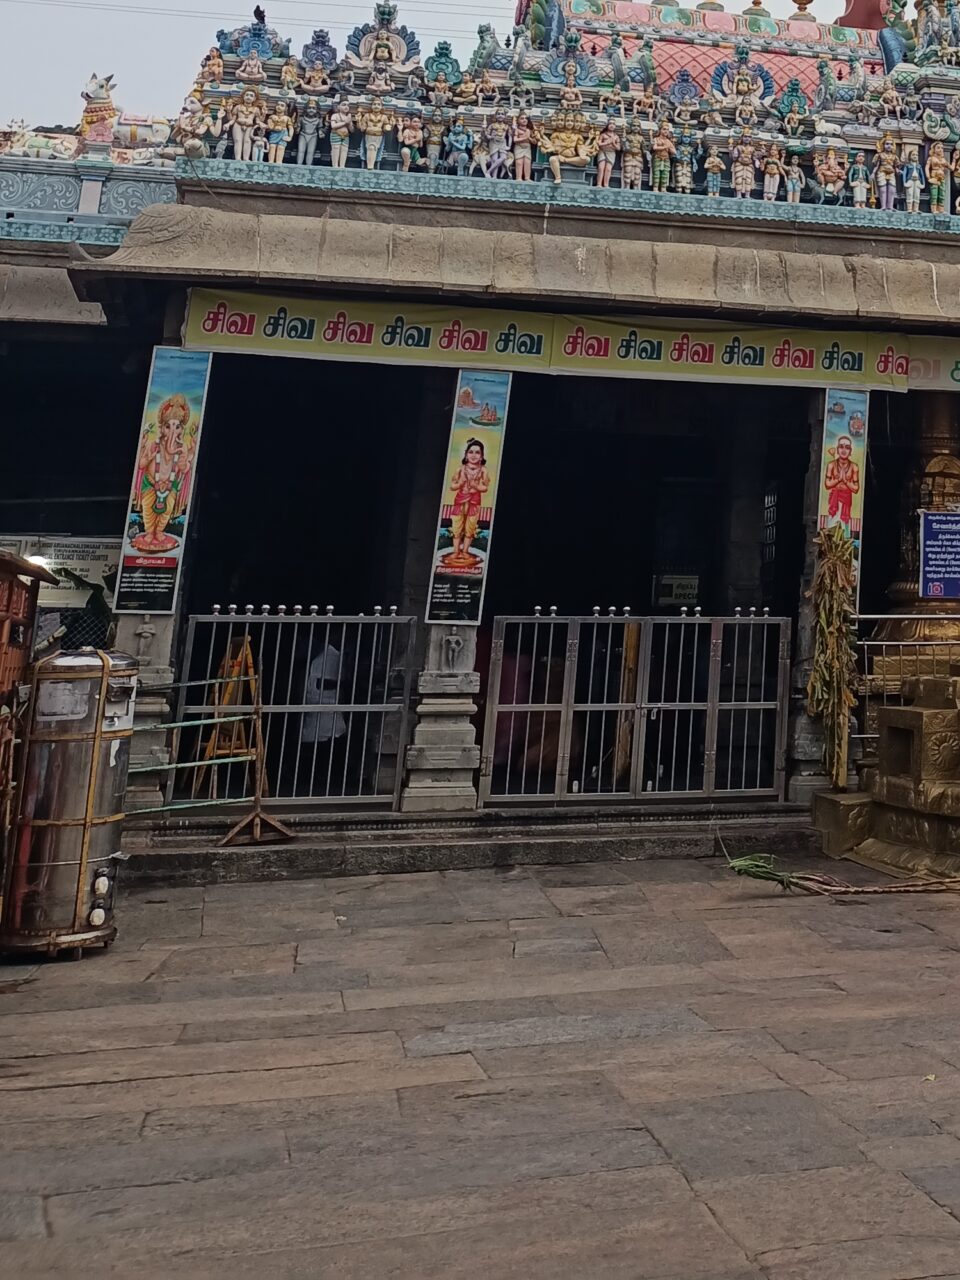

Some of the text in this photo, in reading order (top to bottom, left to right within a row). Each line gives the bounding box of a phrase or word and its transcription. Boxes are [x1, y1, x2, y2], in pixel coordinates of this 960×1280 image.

[201, 301, 543, 356] சிவ சிவ சிவ சிவ சிவ சிவ
[563, 326, 863, 372] சிவ சிவ சிவ சிவ சிவ சிவ
